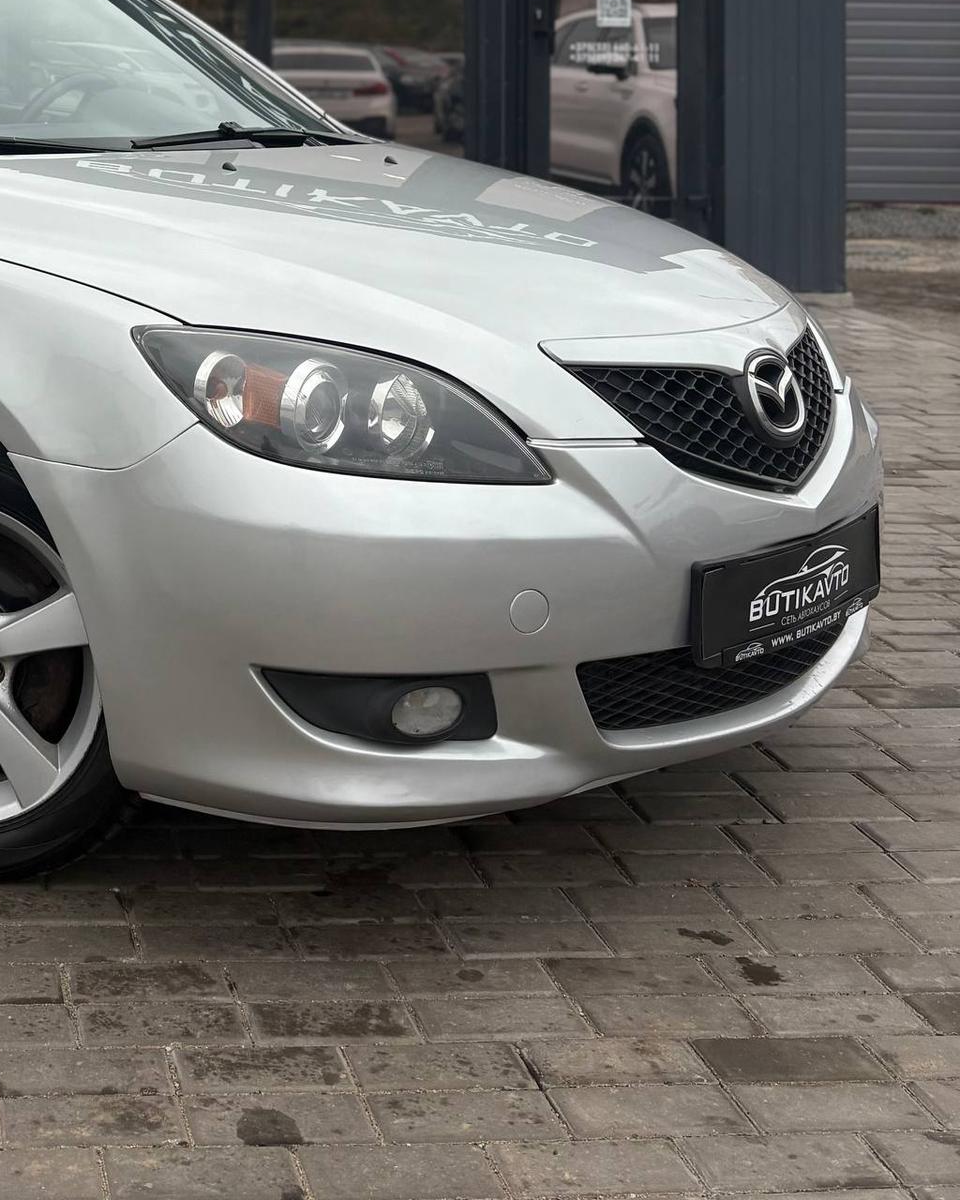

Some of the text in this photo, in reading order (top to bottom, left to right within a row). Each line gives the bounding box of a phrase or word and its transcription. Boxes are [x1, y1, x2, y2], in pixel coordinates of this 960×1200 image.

[749, 564, 849, 622] BUTIKAVTO
[771, 610, 841, 647] WWW. BUTIKAVTO.BY
[781, 615, 797, 626] СЕТЬ
